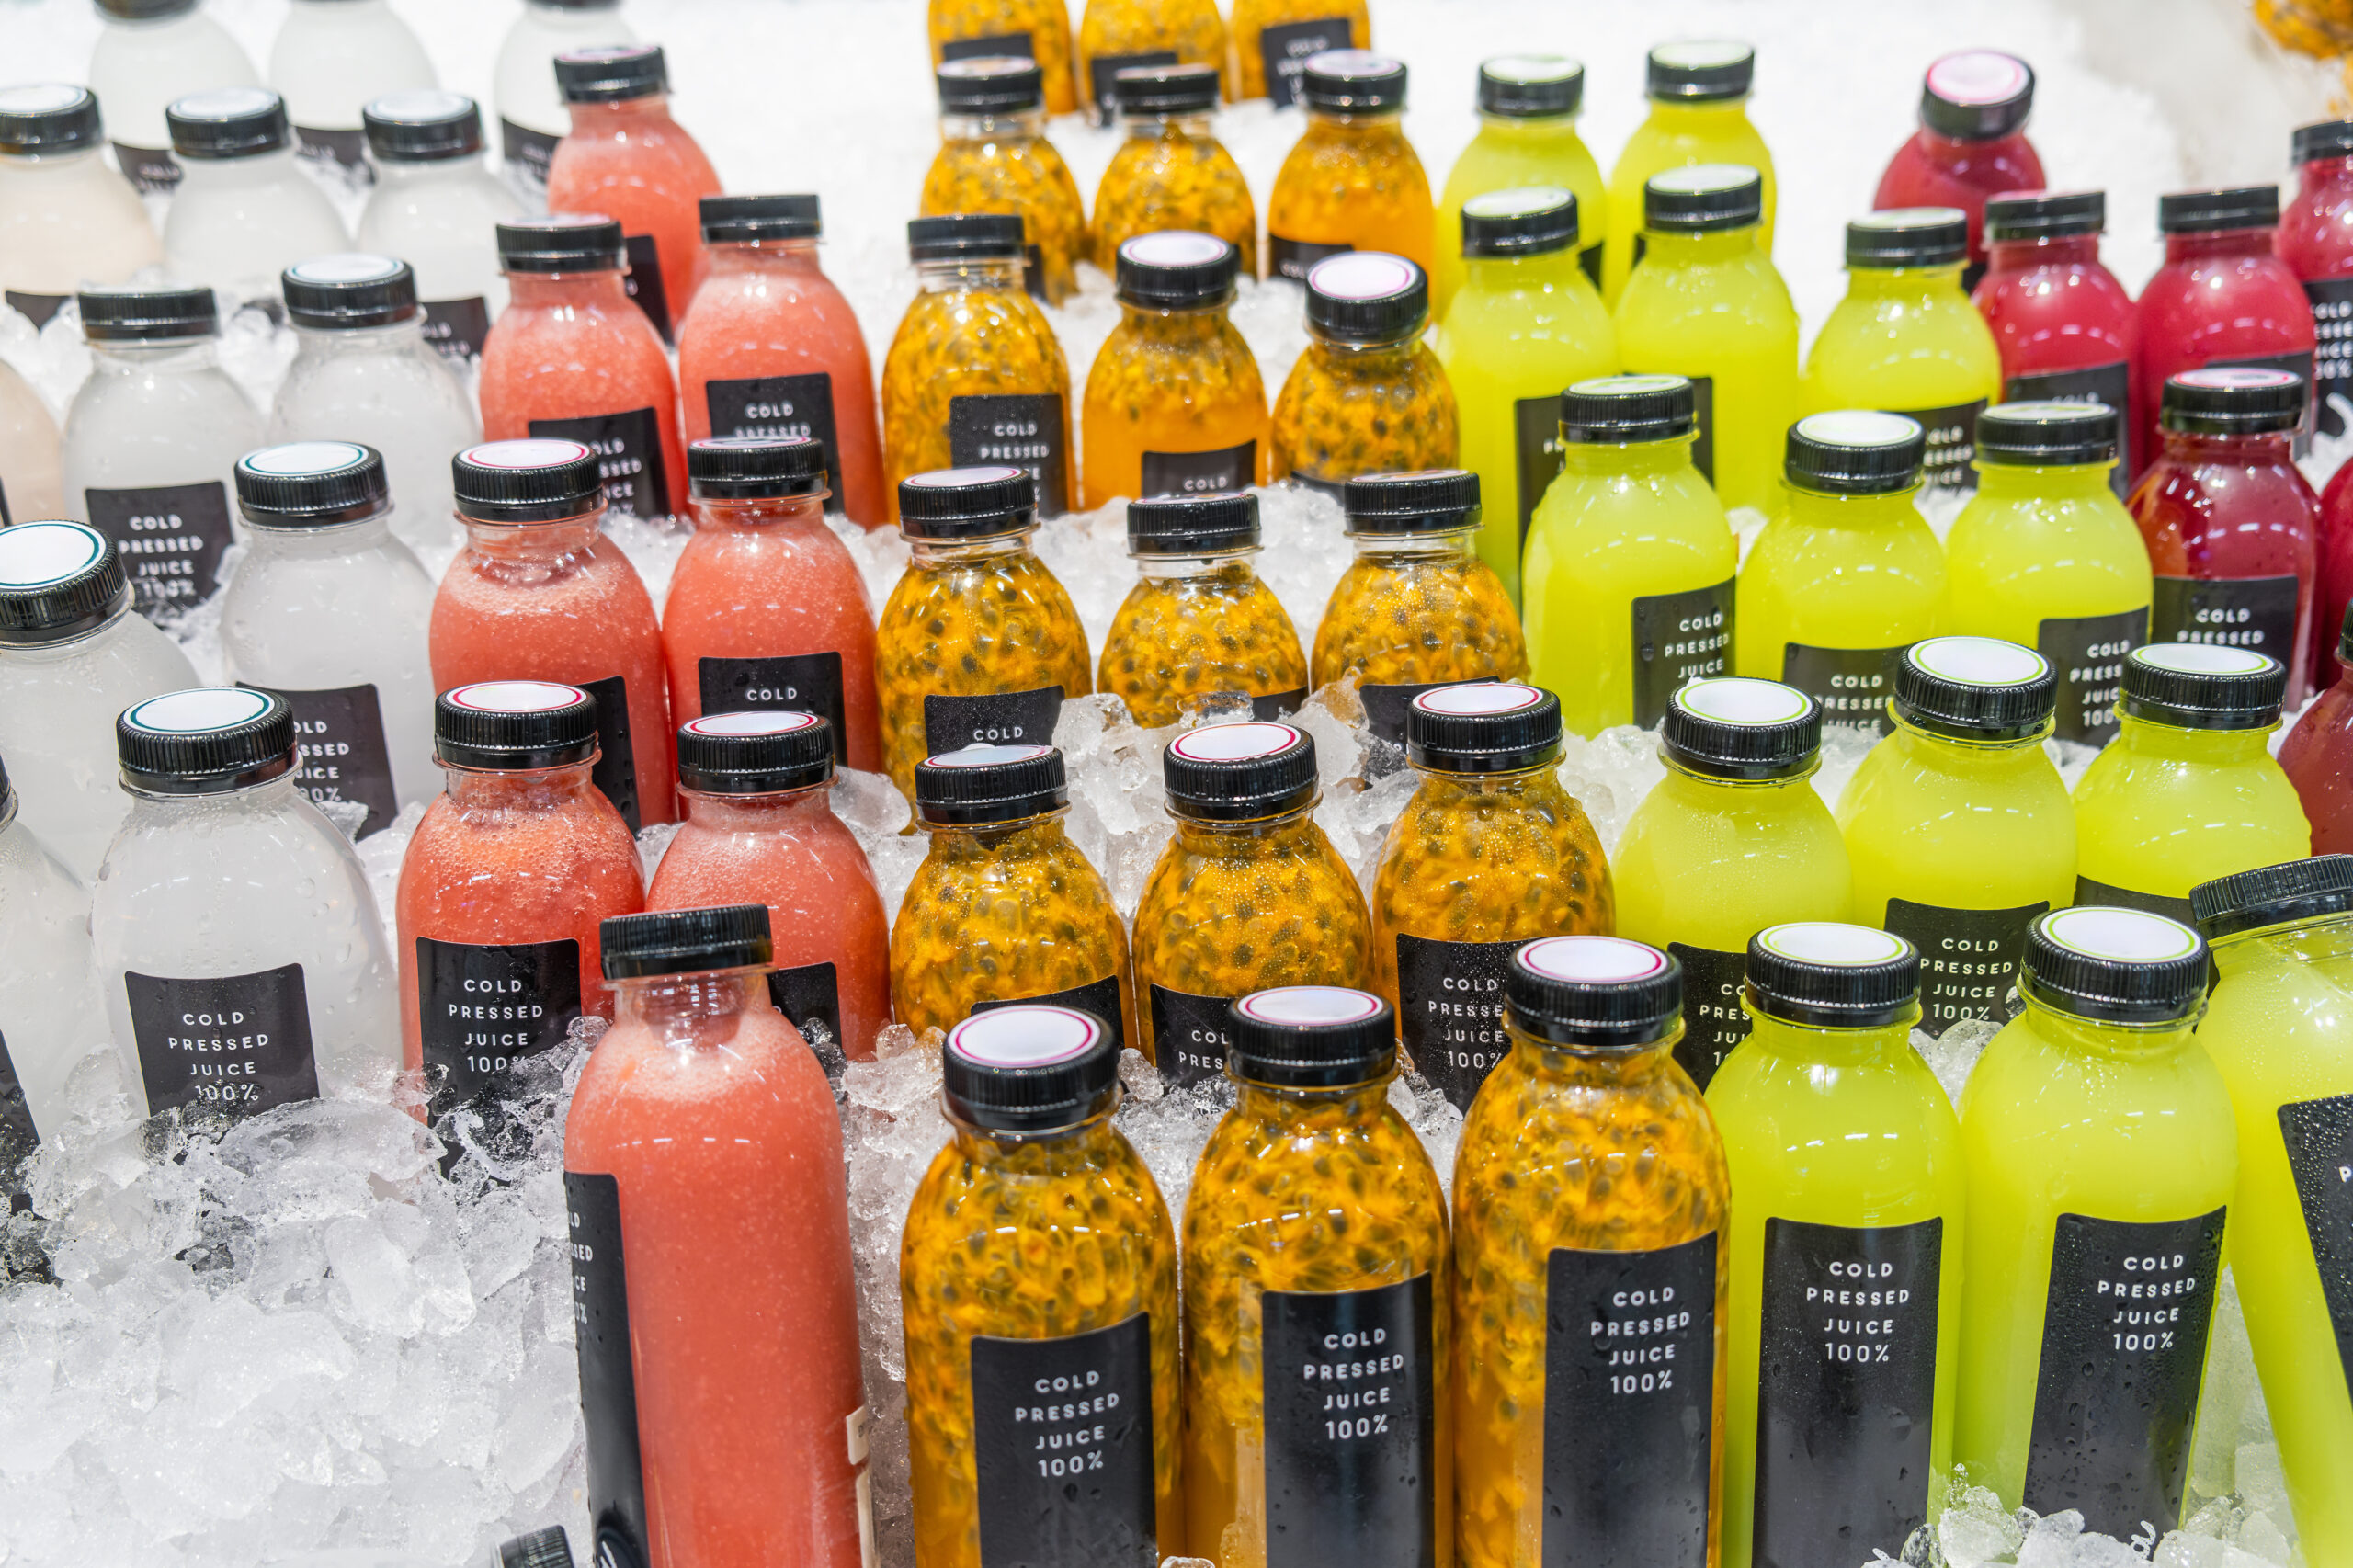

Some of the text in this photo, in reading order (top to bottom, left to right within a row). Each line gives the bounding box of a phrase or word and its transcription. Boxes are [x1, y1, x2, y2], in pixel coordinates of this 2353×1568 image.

[2312, 301, 2353, 319] OLD
[745, 400, 794, 419] COLD
[994, 421, 1038, 437] COLD
[1928, 426, 1963, 445] OLD
[588, 437, 625, 455] OLD
[979, 443, 1050, 459] PRESSED
[599, 457, 642, 478] SSED
[605, 481, 634, 499] ICE
[1183, 475, 1228, 492] COLD
[129, 514, 183, 531] COLD
[118, 535, 204, 554] PRESSED
[139, 559, 194, 576] JUICE
[1679, 611, 1723, 632] COLD
[2195, 608, 2251, 623] COLD
[1665, 631, 1730, 658] PRESSED
[2177, 630, 2265, 645] PRESSED
[2086, 640, 2130, 658] COLD
[1678, 657, 1723, 678] JUICE
[2069, 663, 2122, 683] PRESS
[1830, 674, 1883, 688] COLD
[745, 687, 797, 701] COLD
[2081, 686, 2120, 705] JUIC
[2082, 707, 2115, 728] 100
[293, 720, 327, 733] OLD
[973, 726, 1023, 741] COLD
[300, 742, 350, 756] SSED
[1941, 938, 1999, 952] COLD
[1920, 958, 2013, 974] PRESSED
[464, 979, 522, 993] COLD
[1443, 977, 1498, 991] COLD
[1721, 983, 1745, 996] CO
[1932, 983, 1995, 998] JUICE
[449, 1004, 543, 1020] PRESSED
[1428, 1000, 1503, 1017] PRESSE
[1699, 1005, 1750, 1020] PRES
[1933, 1003, 1990, 1021] 100%
[182, 1012, 244, 1026] COLD
[168, 1034, 269, 1051] PRESSED
[464, 1033, 528, 1046] JUICE
[1191, 1029, 1229, 1044] COL
[1444, 1029, 1505, 1043] JUICE
[1713, 1031, 1746, 1043] JUI
[190, 1062, 256, 1076] JUICE
[1178, 1051, 1223, 1070] PRES
[194, 1084, 259, 1101] 100%
[1829, 1261, 1893, 1278] COLD
[2123, 1254, 2184, 1271] COLD
[1612, 1286, 1675, 1307] COLD
[1806, 1287, 1909, 1306] PRESSED
[2097, 1278, 2196, 1298] PRESSED
[2113, 1307, 2179, 1324] JUICE
[1590, 1312, 1690, 1337] PRESSED
[1824, 1318, 1893, 1335] JUICE
[1324, 1328, 1386, 1350] COLD
[2113, 1331, 2174, 1351] 100%
[1608, 1343, 1676, 1366] JUICE
[1824, 1342, 1890, 1362] 100%
[1303, 1354, 1404, 1380] PRESSED
[1035, 1370, 1100, 1393] COLD
[1610, 1369, 1673, 1394] 100%
[1015, 1392, 1120, 1422] PRESSED
[1324, 1387, 1390, 1410] JUICE
[1325, 1414, 1388, 1440] 100%
[1035, 1425, 1105, 1450] JUICE
[1038, 1449, 1104, 1477] 100%
